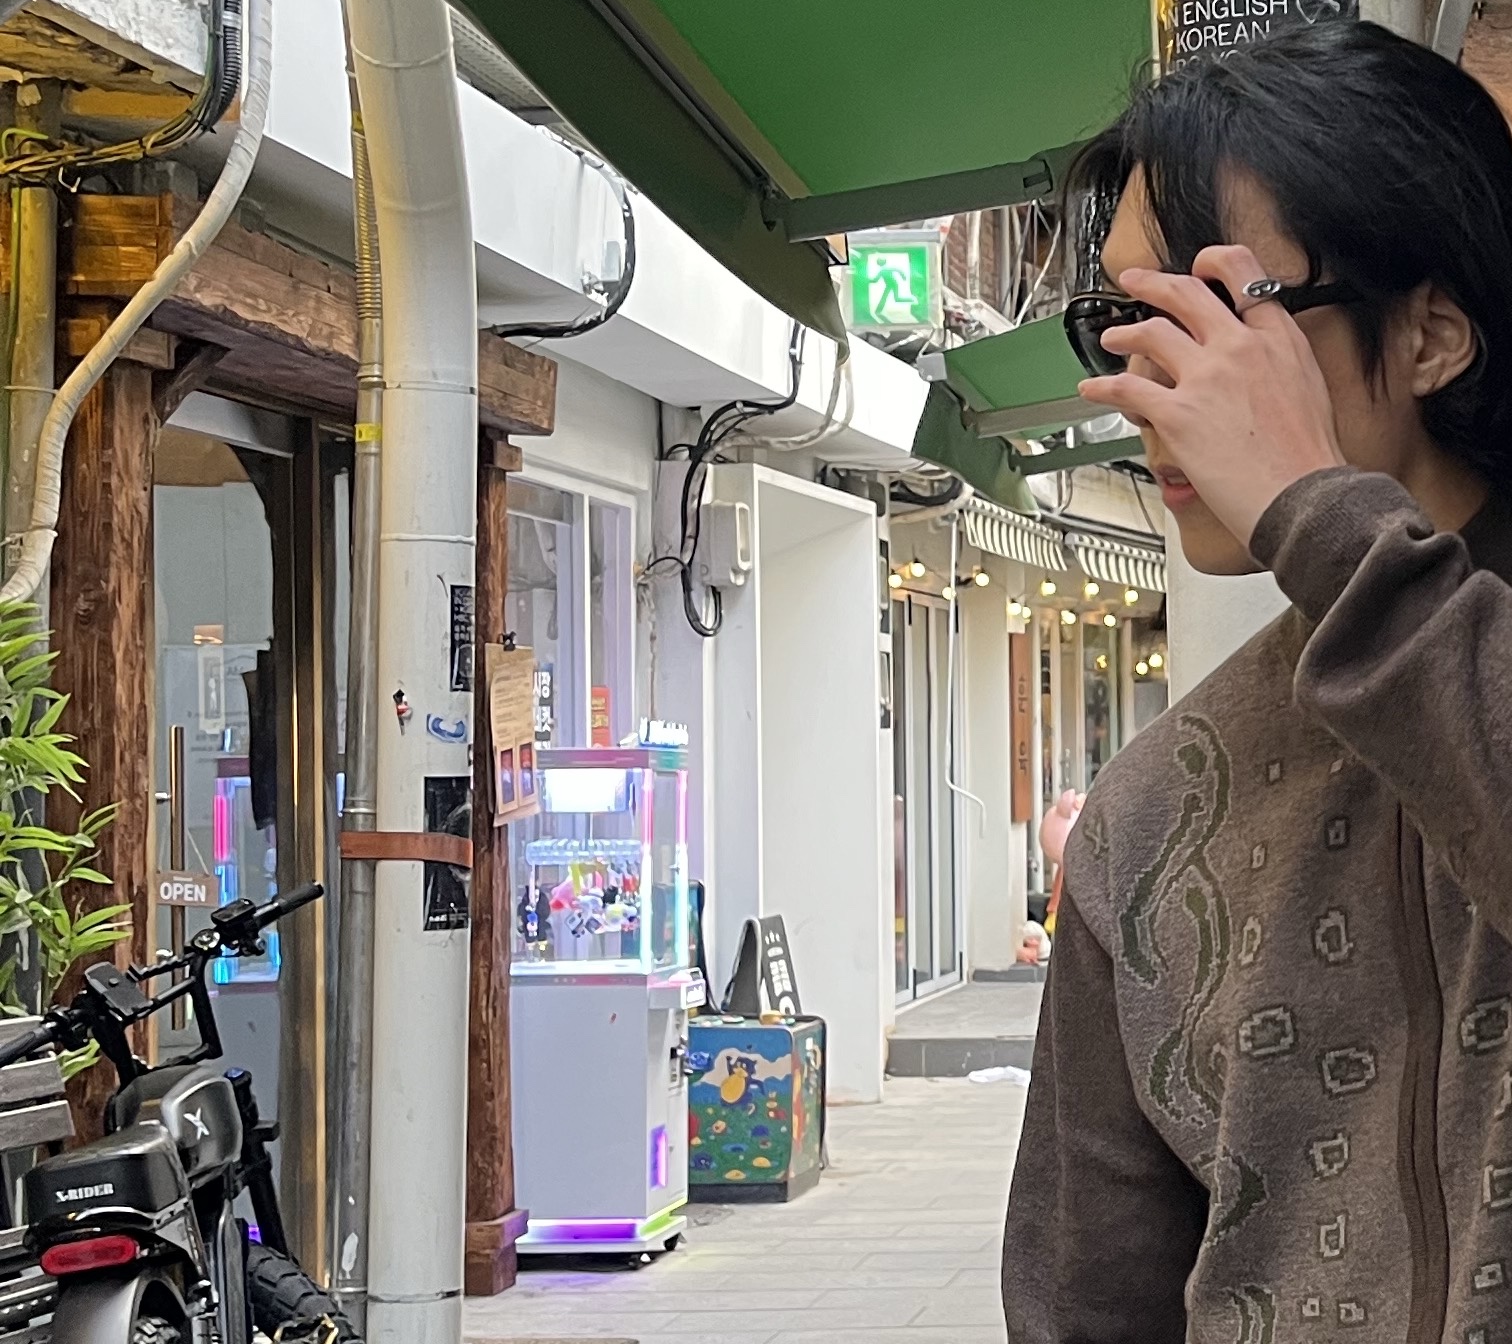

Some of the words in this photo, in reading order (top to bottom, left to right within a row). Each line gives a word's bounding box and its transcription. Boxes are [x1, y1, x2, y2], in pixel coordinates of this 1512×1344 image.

[1175, 19, 1270, 54] KOREAN
[160, 882, 206, 902] OPEN
[55, 1183, 114, 1203] X-RIDER
